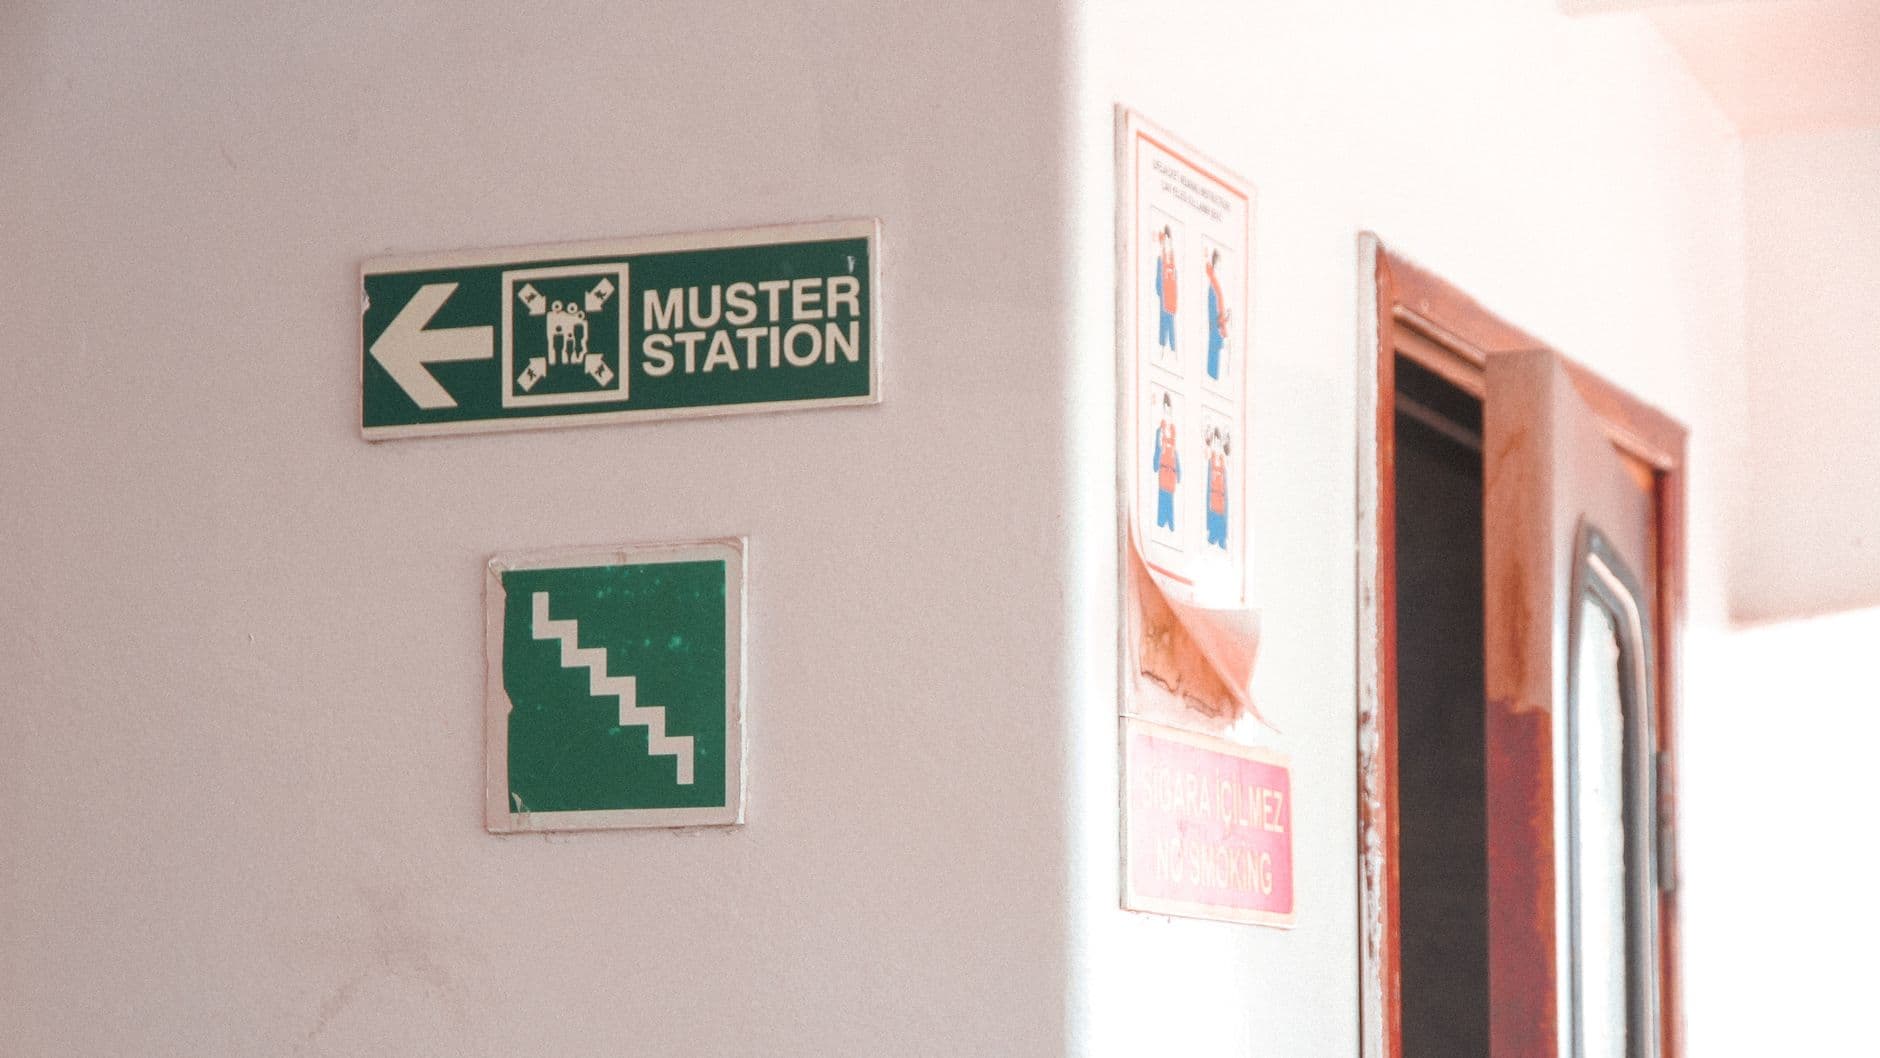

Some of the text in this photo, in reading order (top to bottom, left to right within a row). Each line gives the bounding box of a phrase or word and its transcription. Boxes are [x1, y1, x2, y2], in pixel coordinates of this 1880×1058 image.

[643, 275, 860, 331] MUSTER
[642, 320, 860, 377] STATION
[1155, 836, 1273, 895] NO SMOKING
